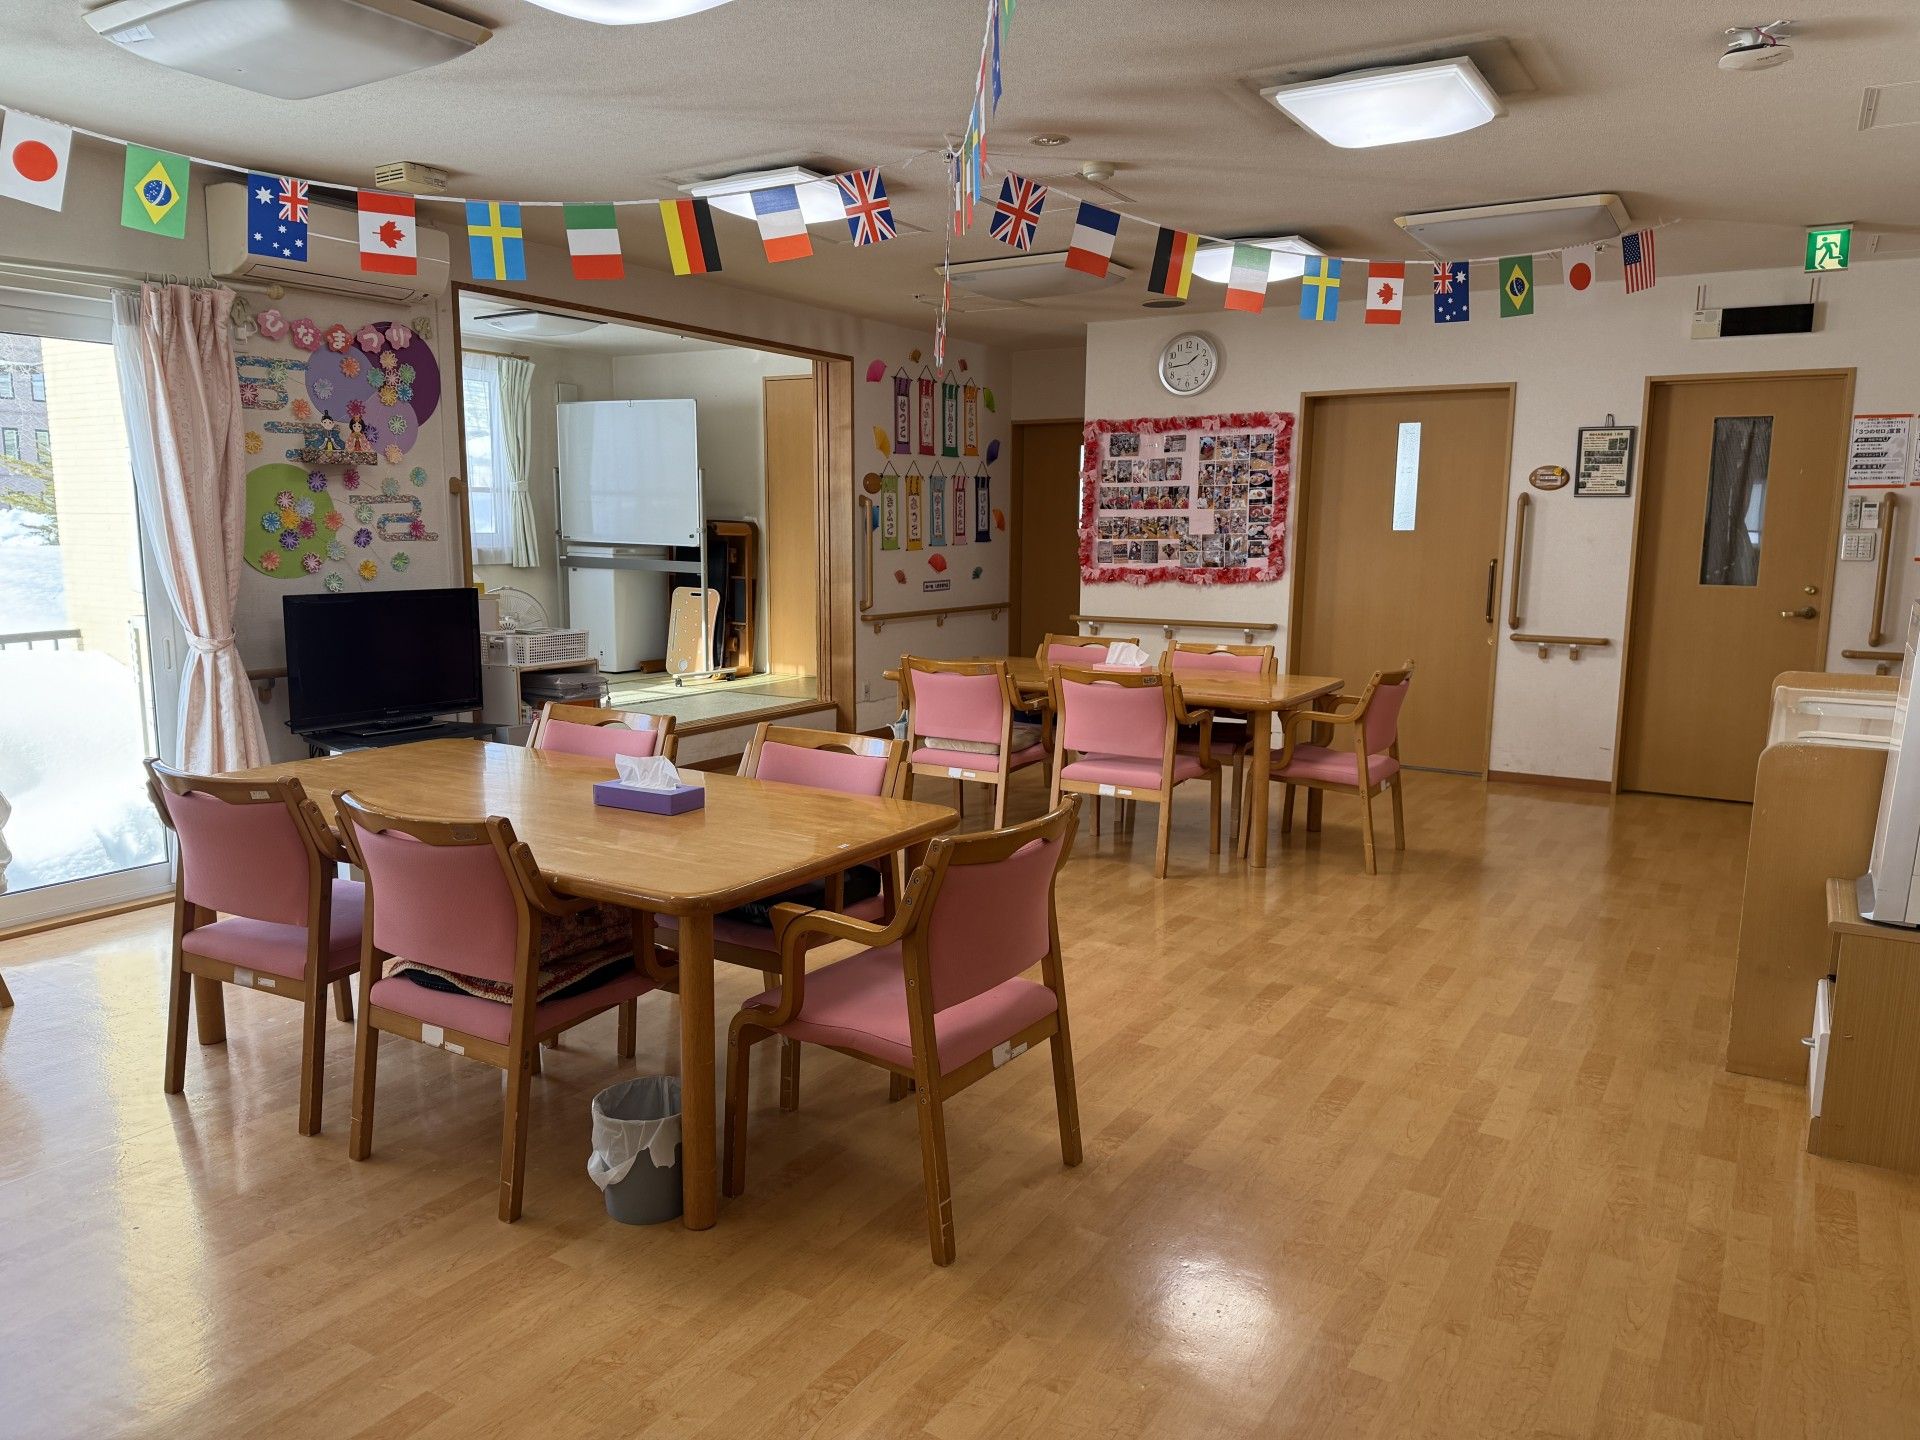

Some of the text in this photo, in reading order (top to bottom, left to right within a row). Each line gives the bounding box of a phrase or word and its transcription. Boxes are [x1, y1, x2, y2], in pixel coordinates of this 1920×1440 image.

[265, 310, 404, 350] ひなまつり
